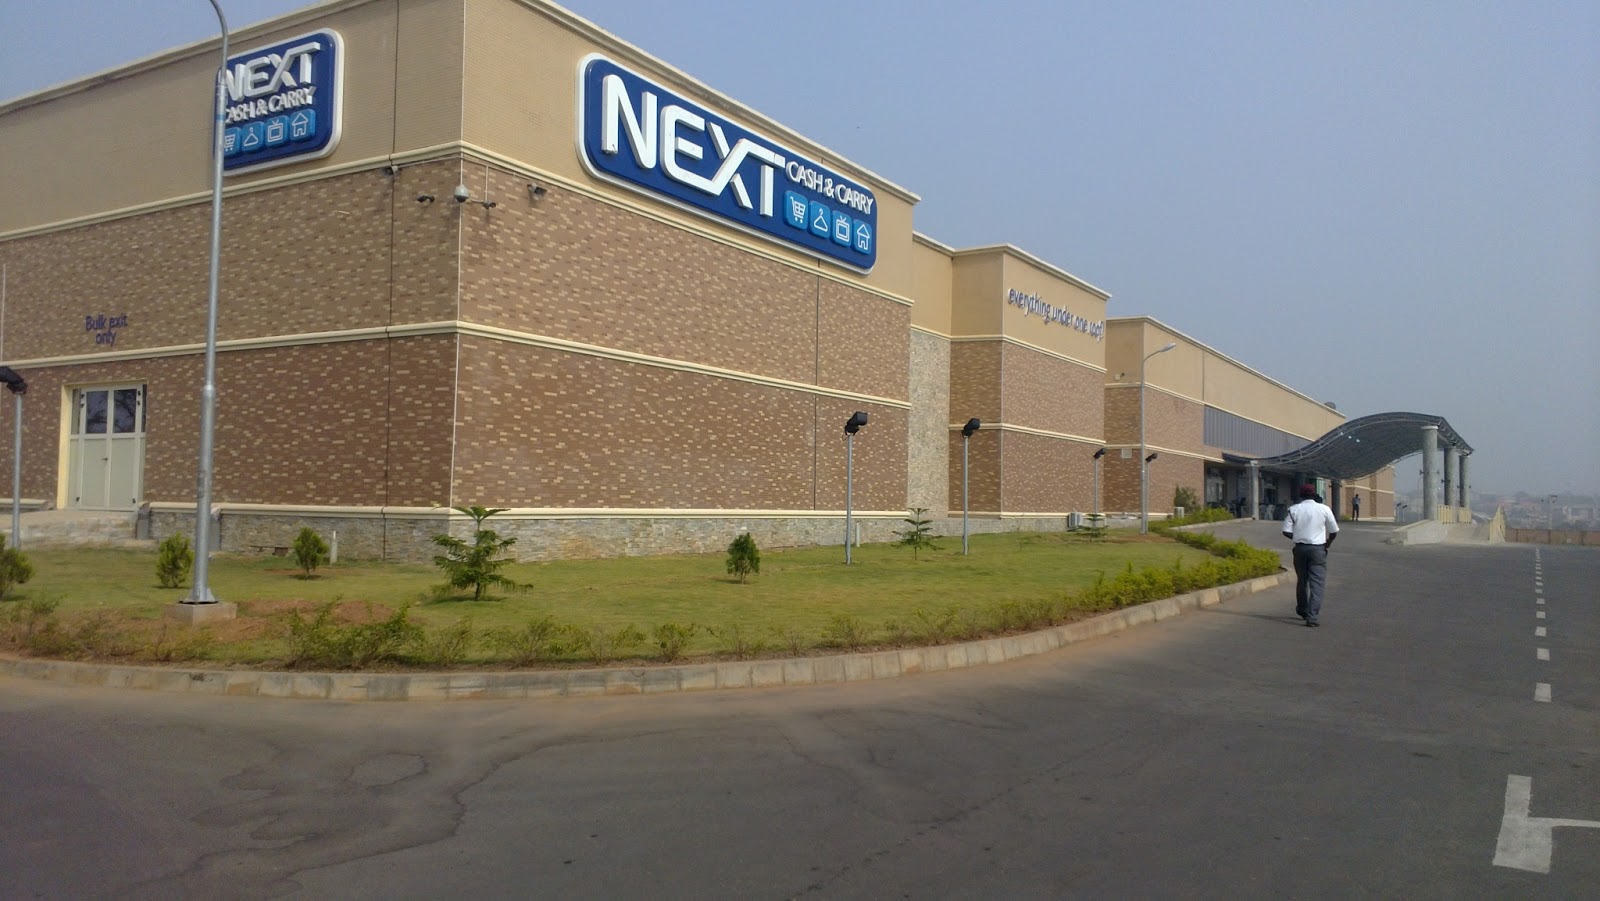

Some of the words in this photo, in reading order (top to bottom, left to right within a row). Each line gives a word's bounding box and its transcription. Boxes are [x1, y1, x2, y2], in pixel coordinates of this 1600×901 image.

[217, 41, 321, 102] NEXT
[268, 86, 317, 113] CARRY
[601, 74, 786, 218] NEXT
[785, 161, 823, 193] CASH
[823, 178, 835, 199] &
[835, 184, 874, 215] CARRY
[85, 314, 107, 331] Bulk
[1008, 288, 1051, 325] everything
[1051, 305, 1074, 328] under
[1073, 315, 1088, 333] one
[95, 328, 117, 347] only
